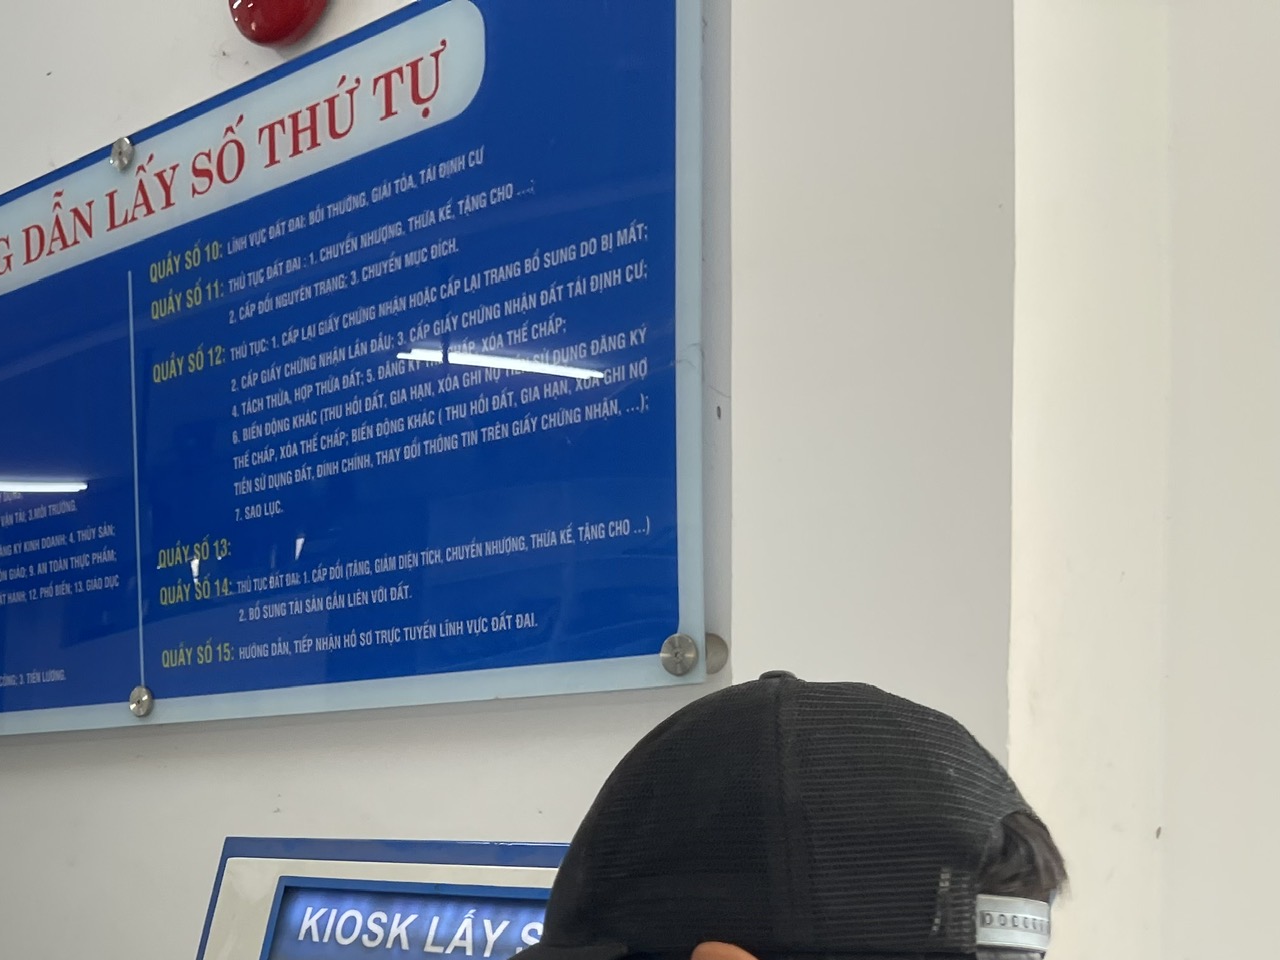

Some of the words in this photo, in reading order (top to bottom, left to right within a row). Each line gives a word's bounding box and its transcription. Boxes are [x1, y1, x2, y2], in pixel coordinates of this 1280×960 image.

[21, 190, 97, 267] DẪN
[105, 152, 181, 233] LẤY
[190, 114, 247, 198] SỐ
[257, 76, 362, 169] THỨ
[372, 40, 448, 120] TỰ
[149, 250, 181, 283] QUẦY
[184, 240, 201, 270] SỐ
[204, 238, 223, 263] 10:
[151, 289, 182, 320] QUẦY
[185, 279, 202, 308] SỐ
[205, 278, 224, 302] 11:
[152, 353, 184, 383] QUẦY
[187, 344, 204, 373] SỐ
[207, 344, 225, 367] 12:
[161, 642, 193, 668] QUẦY
[196, 638, 212, 664] SỐ
[216, 642, 234, 662] 15:
[297, 906, 419, 950] KIOSK
[423, 909, 510, 957] LẤY
[515, 921, 544, 953] S
